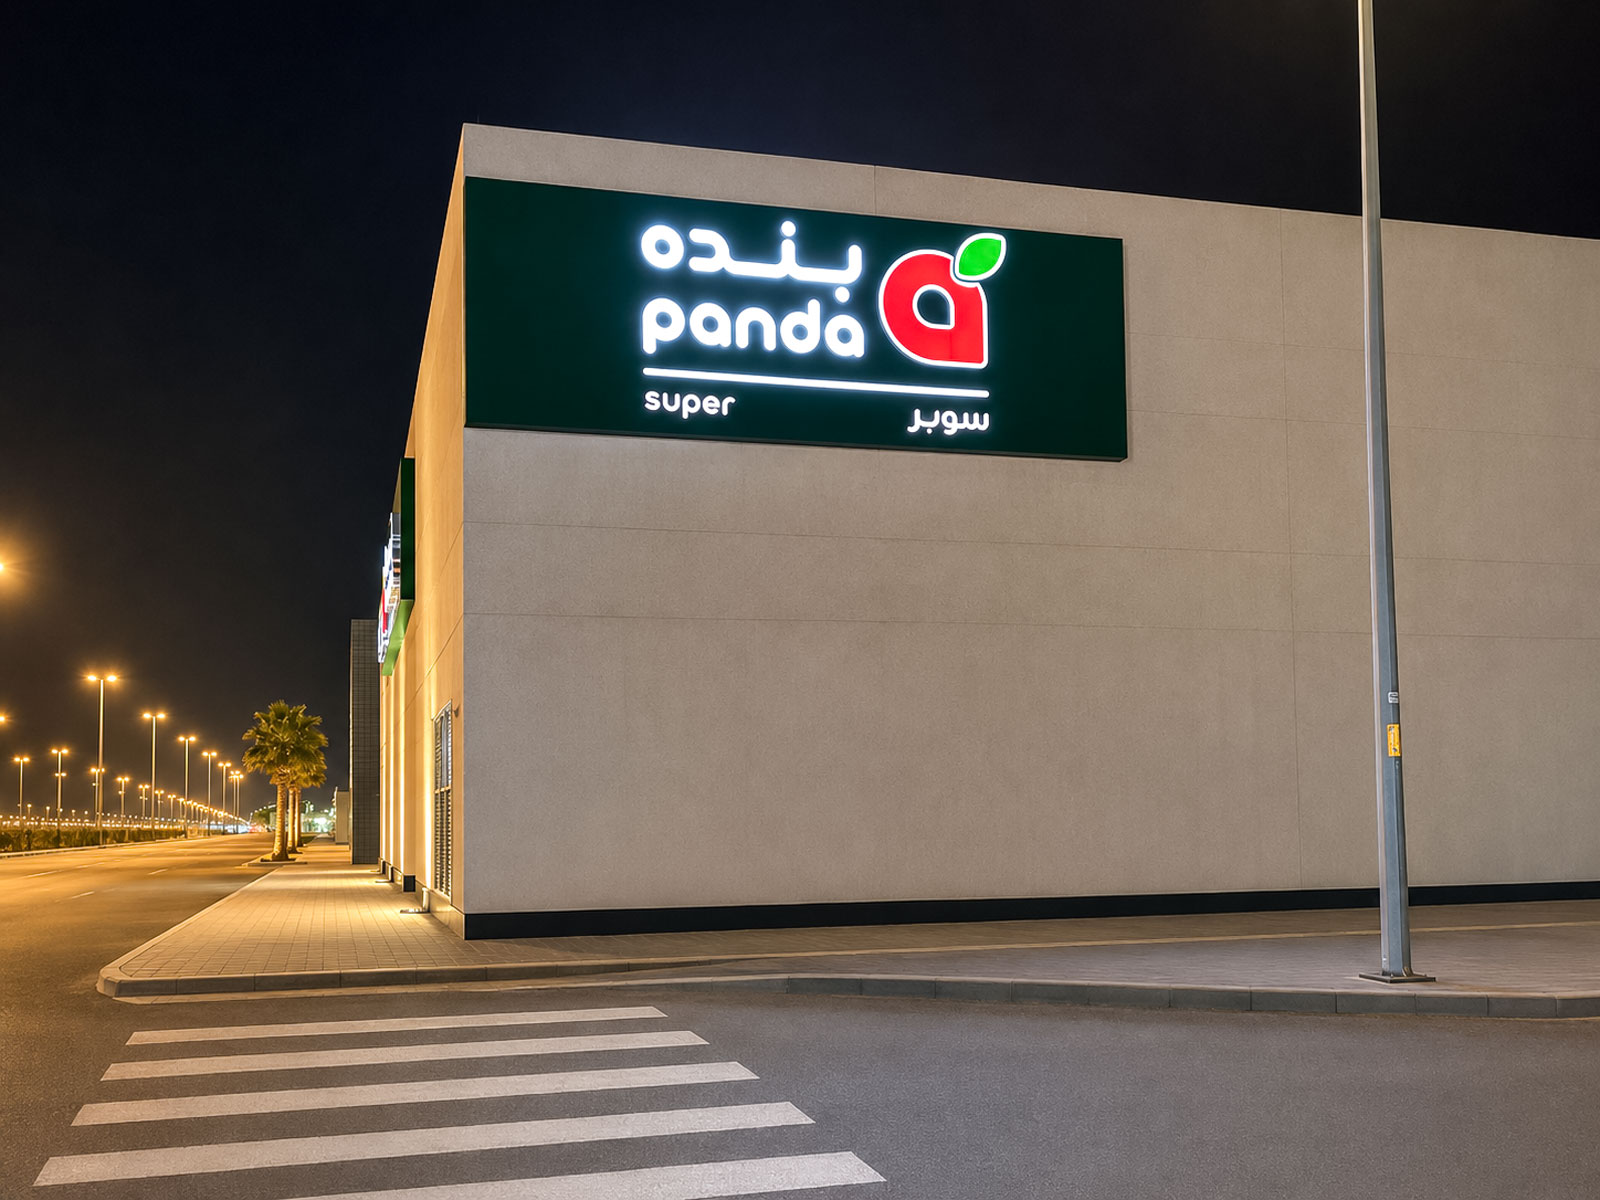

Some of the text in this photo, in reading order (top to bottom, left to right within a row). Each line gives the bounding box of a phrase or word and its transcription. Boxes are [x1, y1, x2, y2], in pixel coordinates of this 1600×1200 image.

[640, 220, 863, 304] بنده
[641, 297, 865, 358] panda
[644, 390, 736, 420] super
[906, 408, 990, 436] سوبر
